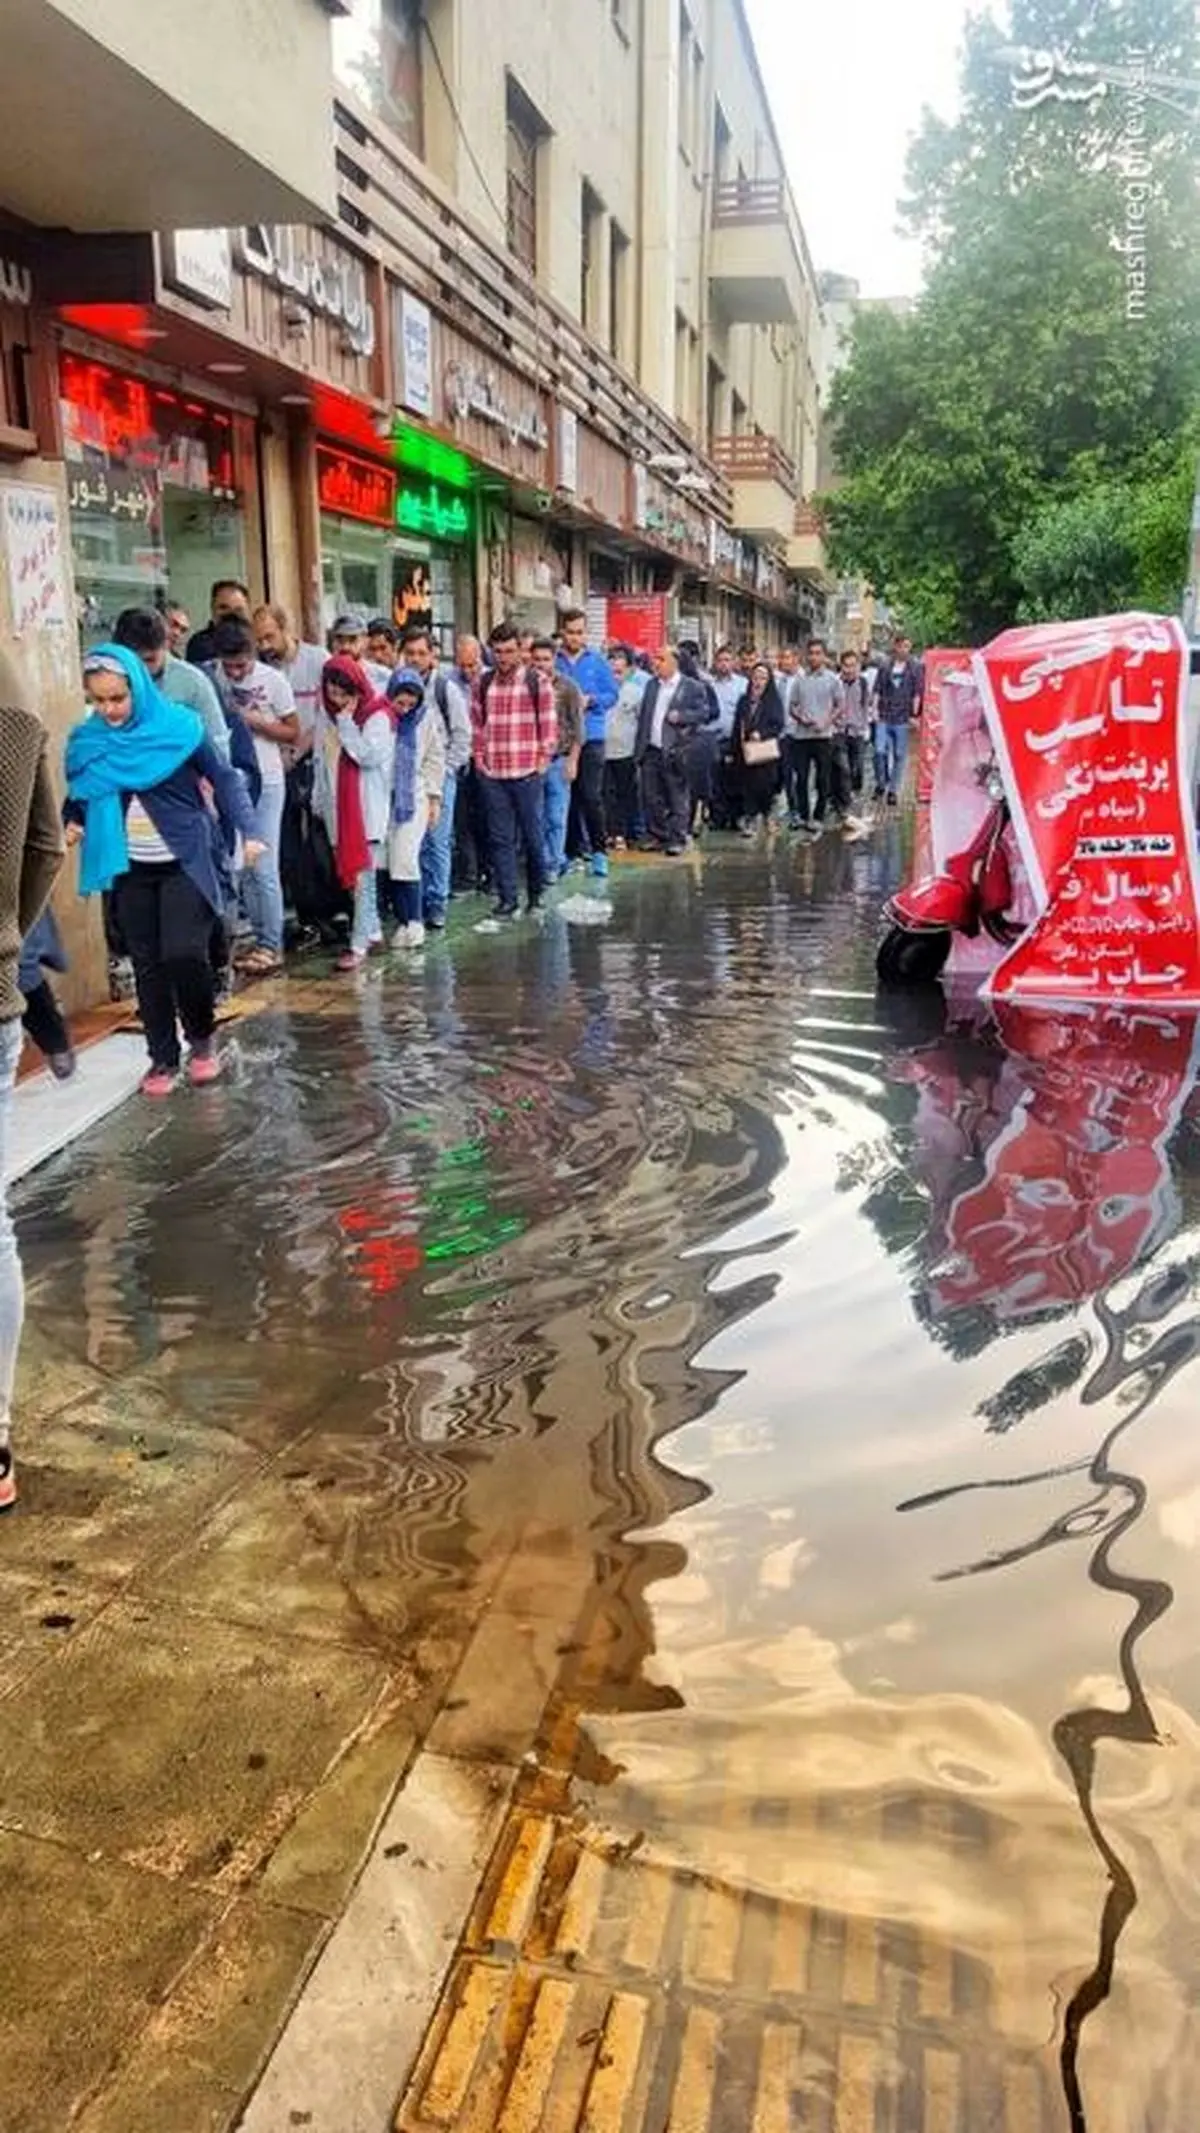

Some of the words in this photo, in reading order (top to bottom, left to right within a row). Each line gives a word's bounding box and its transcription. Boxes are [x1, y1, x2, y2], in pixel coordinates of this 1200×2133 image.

[1024, 677, 1164, 766] تایپ
[1094, 752, 1170, 792] پرینت
[1092, 870, 1183, 906] ارسال
[1105, 958, 1187, 996] چاپ
